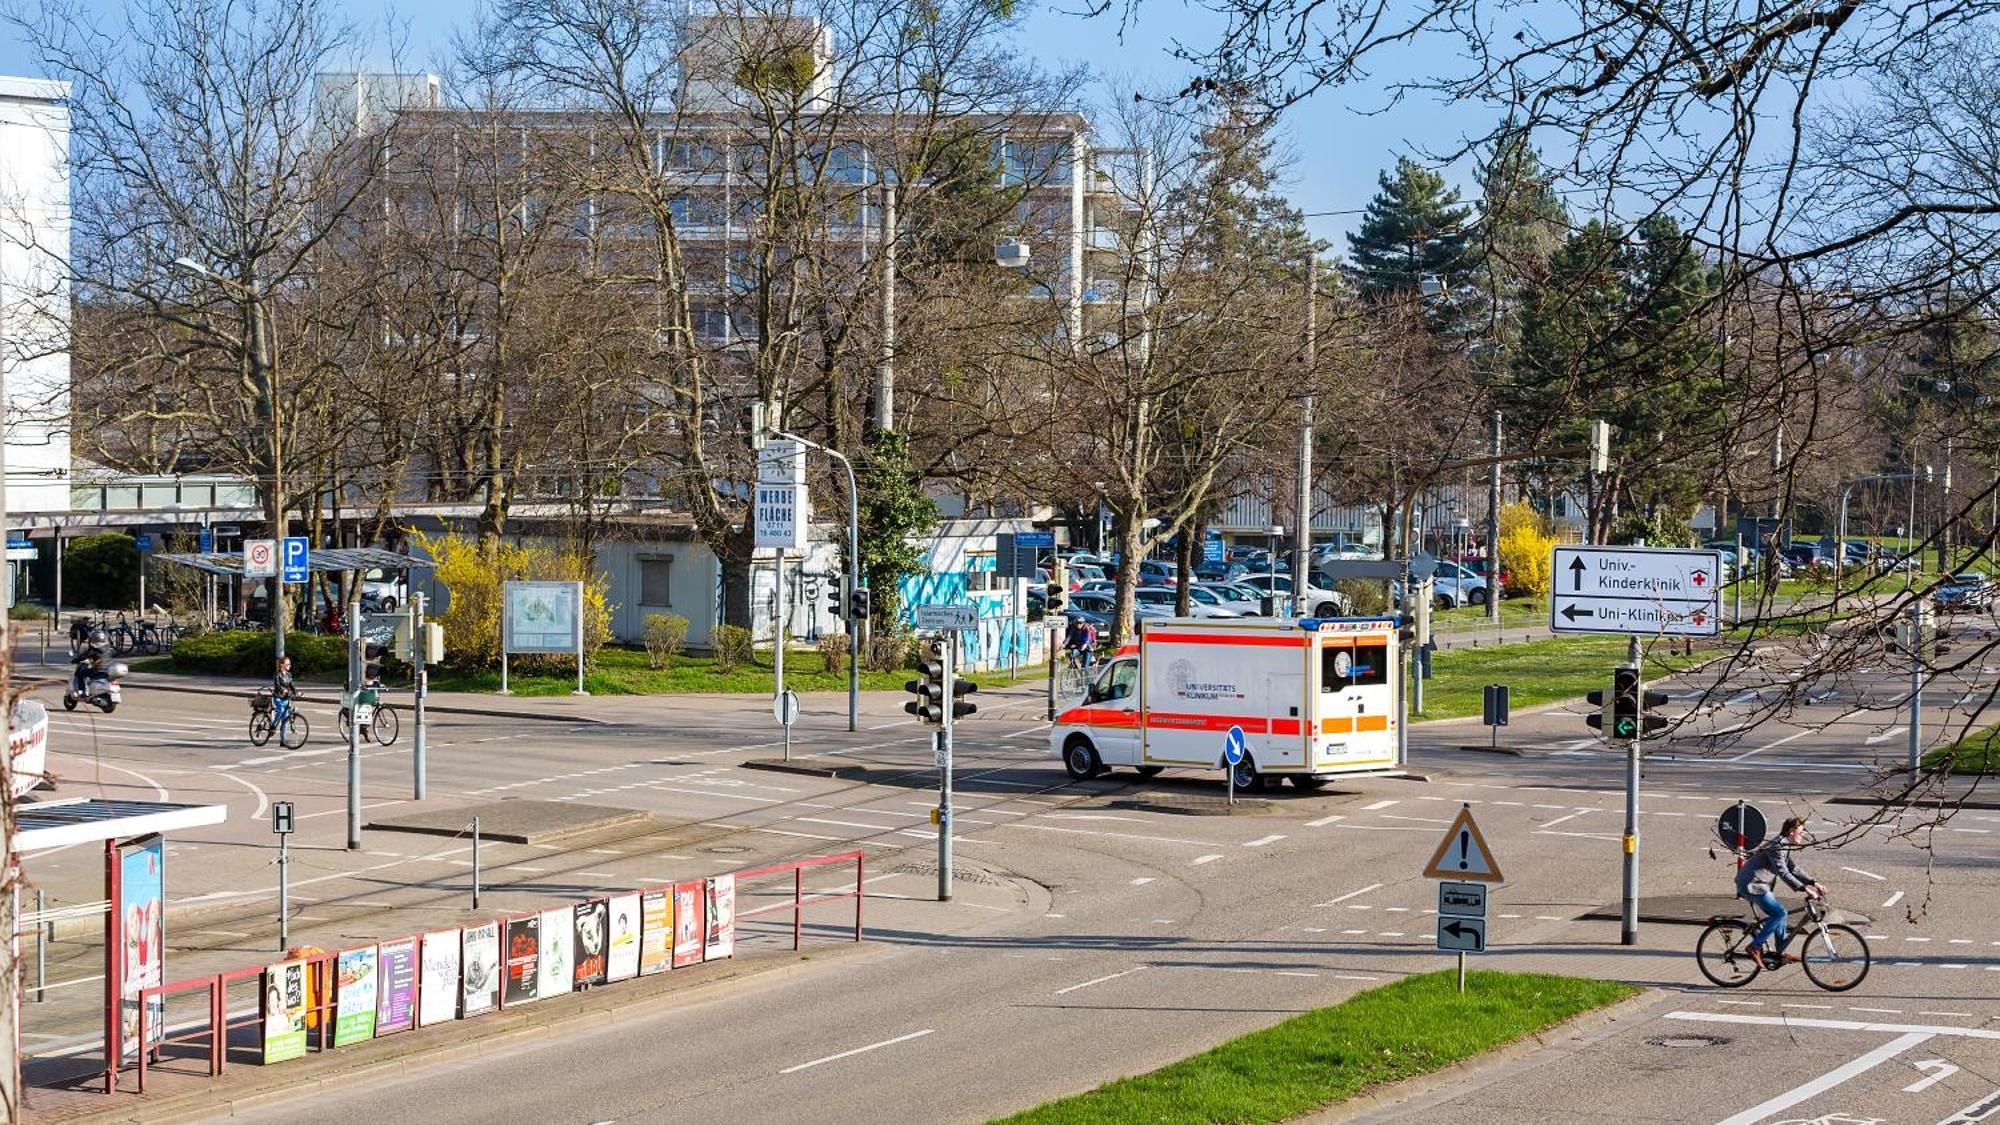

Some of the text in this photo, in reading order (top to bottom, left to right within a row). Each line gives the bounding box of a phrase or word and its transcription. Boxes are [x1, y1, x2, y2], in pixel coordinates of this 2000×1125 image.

[760, 490, 793, 504] WERBE
[759, 506, 793, 521] FLÄCHE
[255, 550, 266, 559] 30
[288, 541, 304, 565] P
[1599, 558, 1636, 572] Univ.-
[1599, 575, 1681, 591] Kinderklinik
[1599, 607, 1684, 622] Uni-Kliniken
[1186, 692, 1219, 700] KLINIKUM
[275, 805, 292, 831] H
